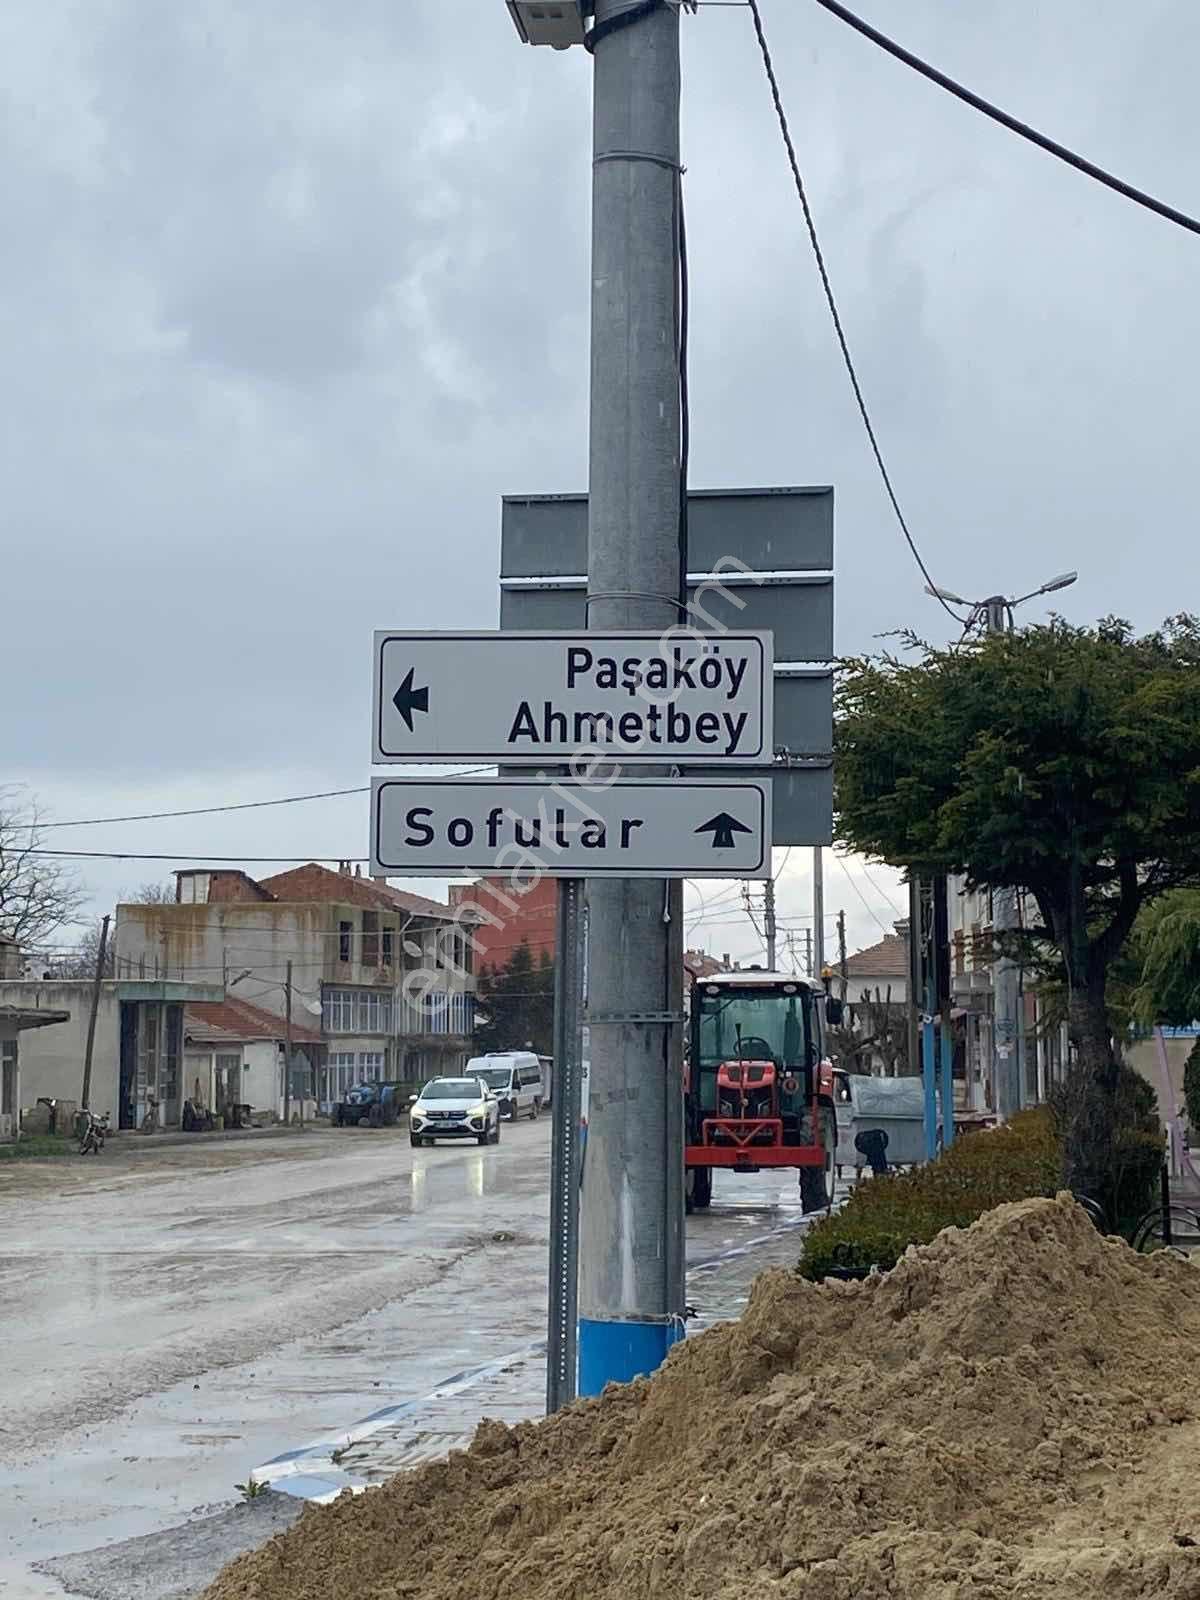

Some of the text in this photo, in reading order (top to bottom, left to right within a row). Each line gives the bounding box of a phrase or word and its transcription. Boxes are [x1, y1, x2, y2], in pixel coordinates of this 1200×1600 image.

[567, 646, 748, 700] Paşaköy
[507, 700, 748, 755] Ahmetbey
[404, 807, 644, 849] Sofular
